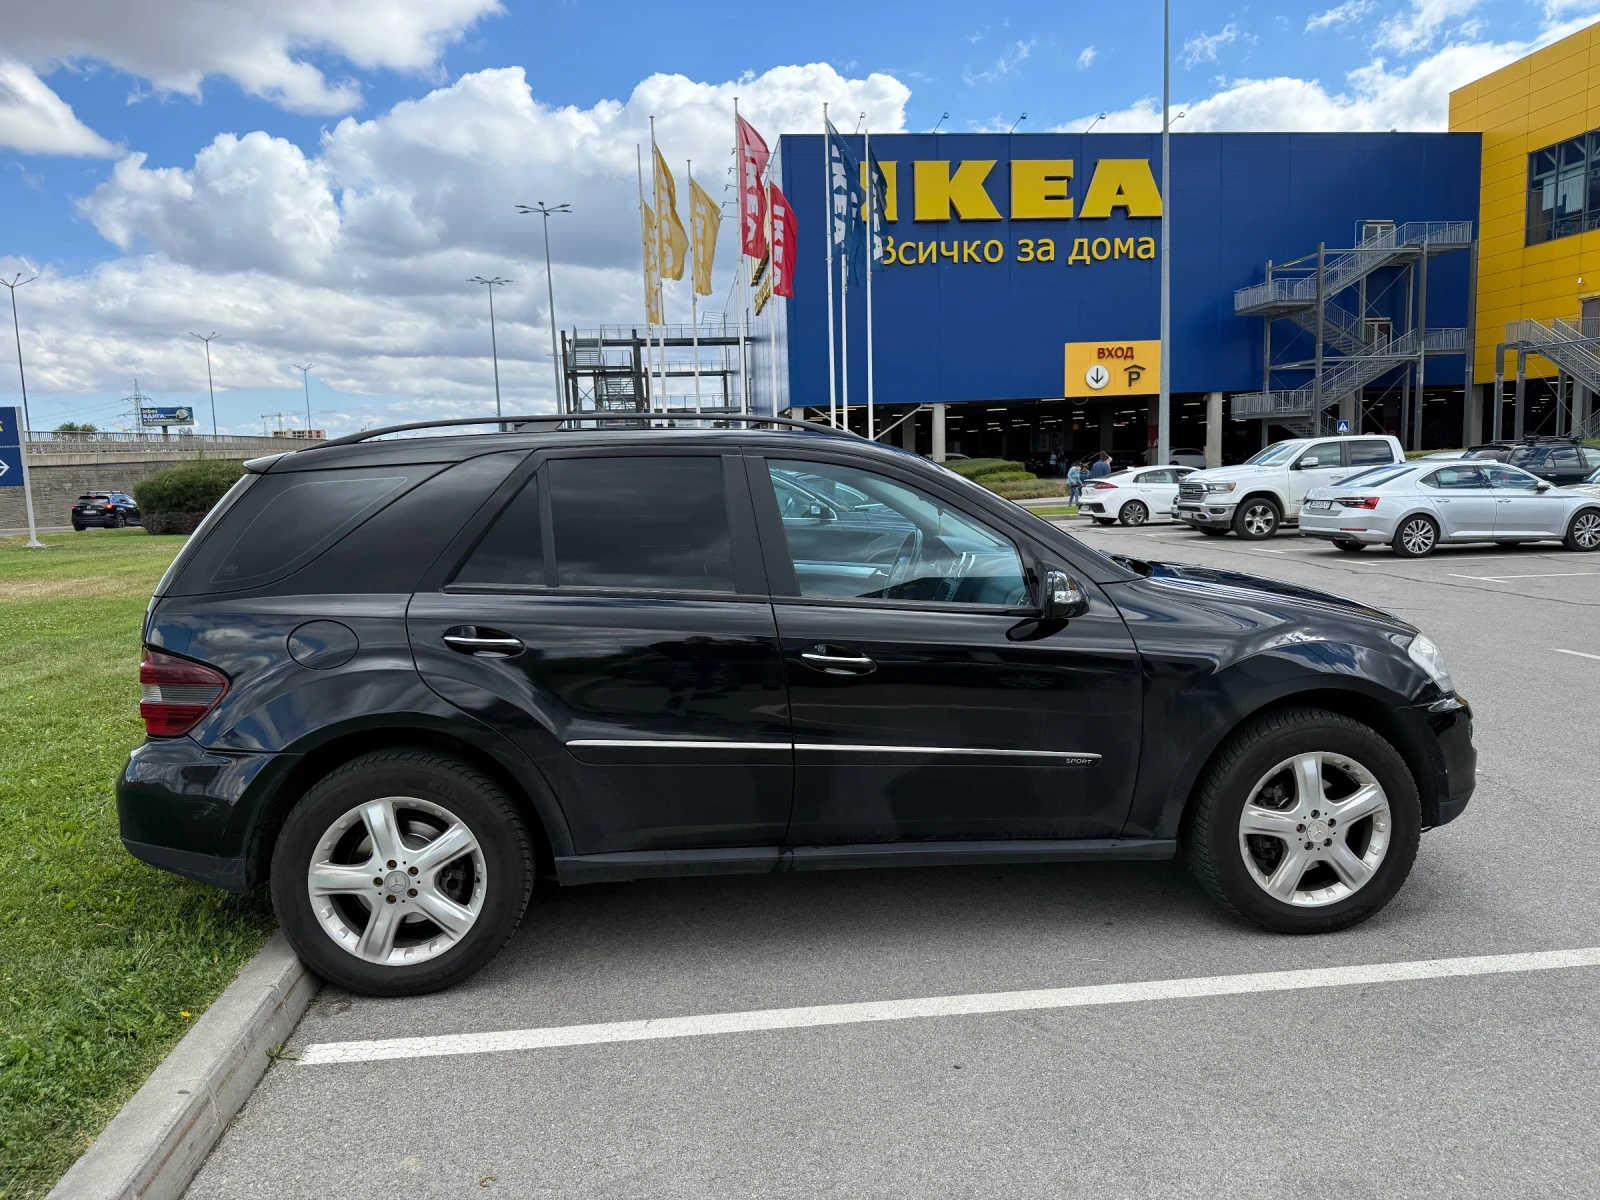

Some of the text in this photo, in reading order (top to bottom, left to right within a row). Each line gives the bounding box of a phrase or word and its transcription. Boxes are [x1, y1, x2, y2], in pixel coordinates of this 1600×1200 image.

[832, 144, 848, 246] IKEA
[859, 158, 1162, 221] IKEA
[773, 204, 786, 288] IKEA
[1016, 237, 1055, 263] за
[1067, 235, 1156, 266] дома
[1097, 346, 1134, 360] ВХОД
